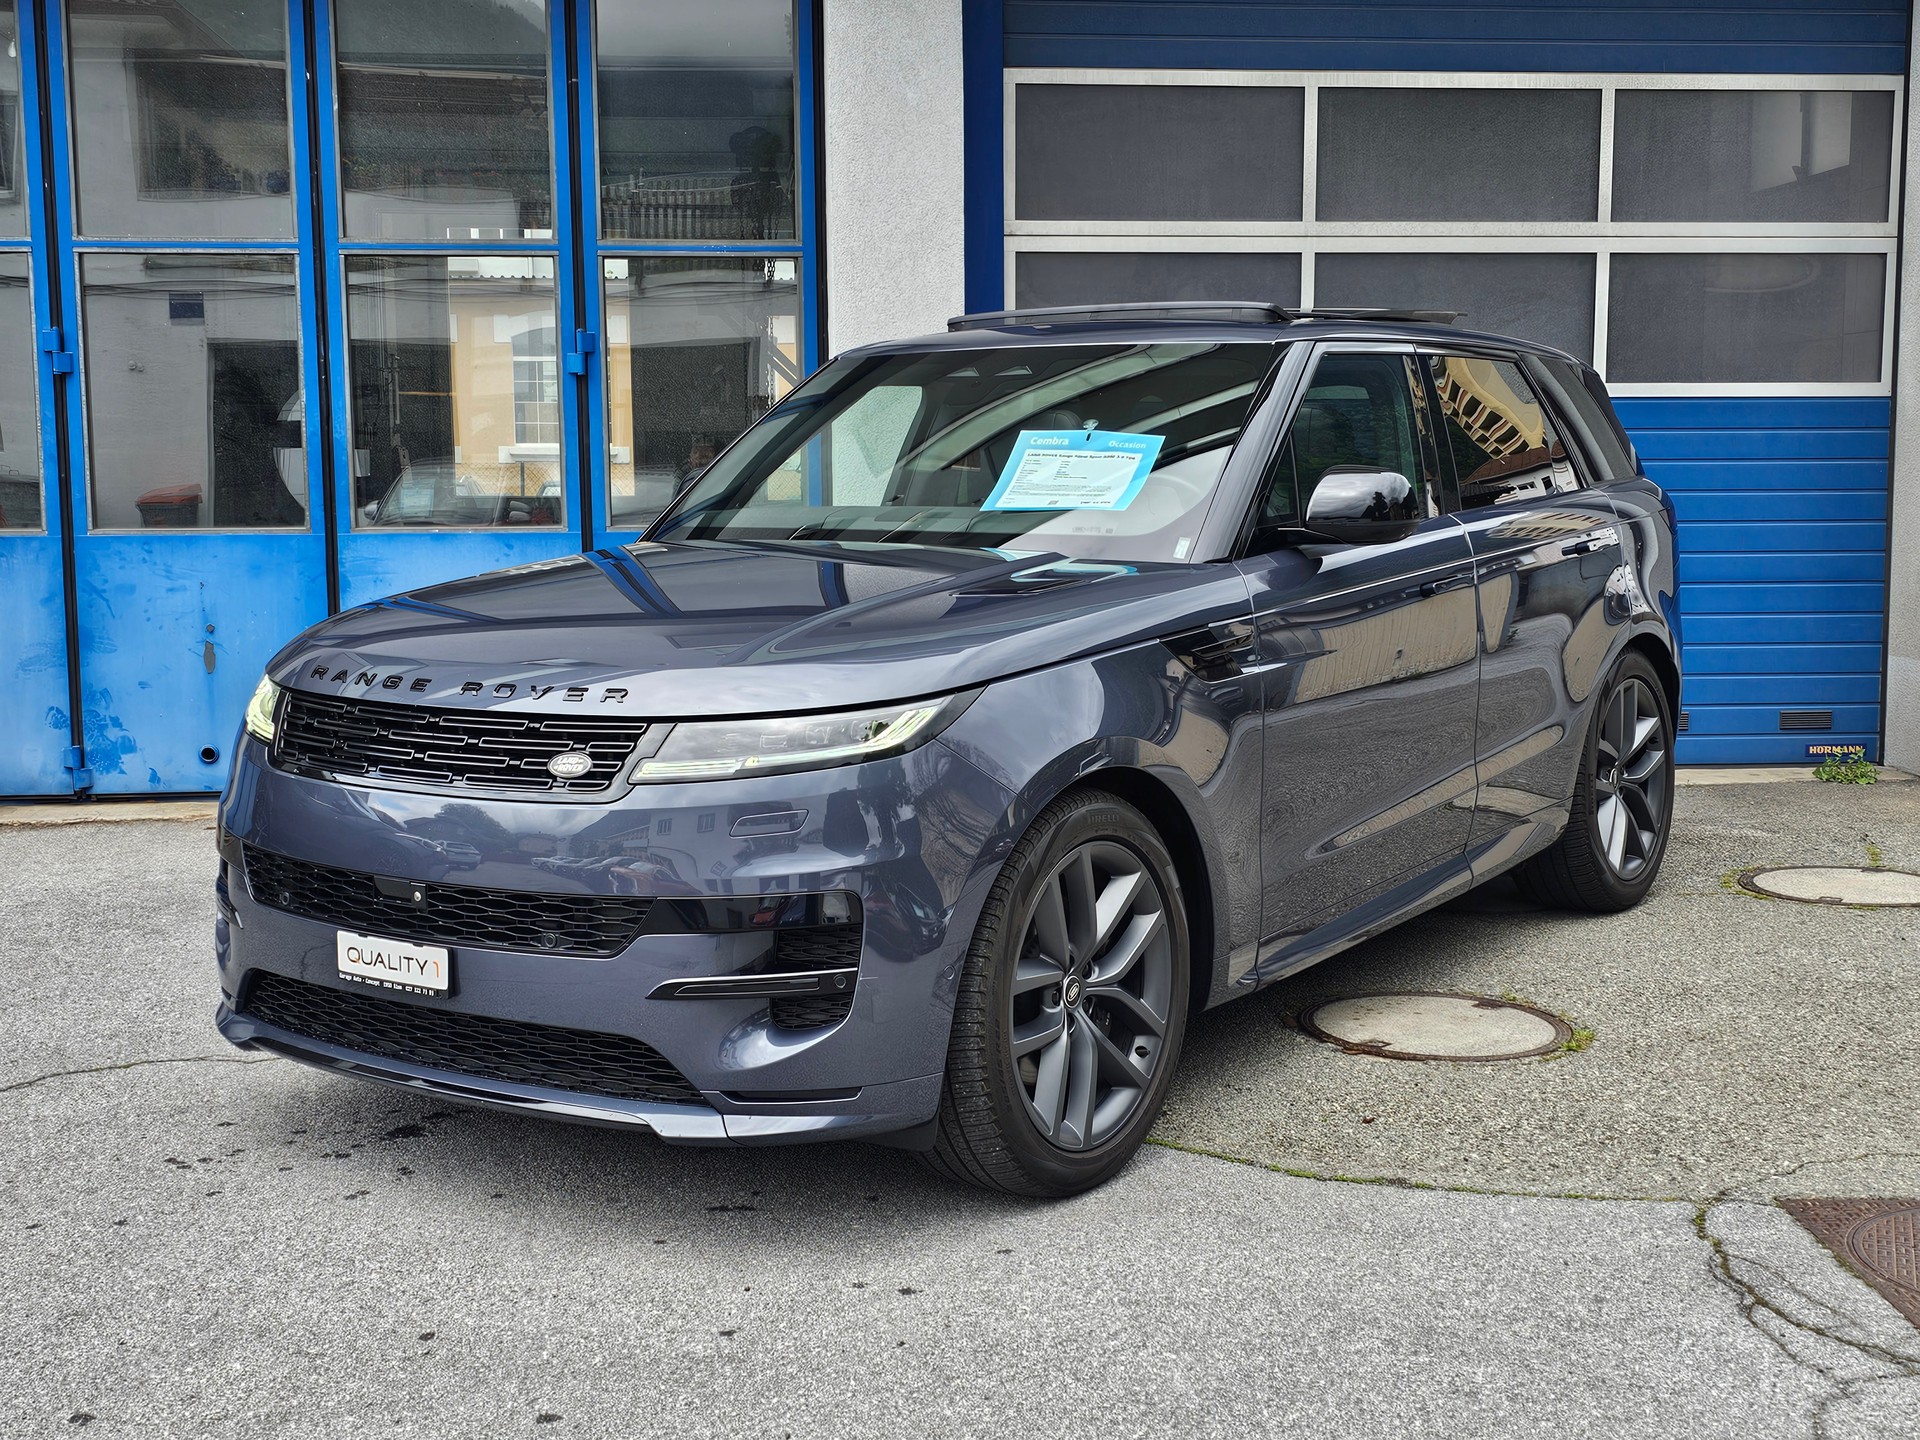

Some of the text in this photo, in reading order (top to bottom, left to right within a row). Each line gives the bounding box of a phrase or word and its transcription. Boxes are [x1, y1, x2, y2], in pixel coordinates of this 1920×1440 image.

[1030, 436, 1147, 449] Cembra Occasion
[311, 664, 630, 703] RANGE ROVER
[557, 764, 584, 772] ROVER
[346, 946, 428, 976] QUALITY
